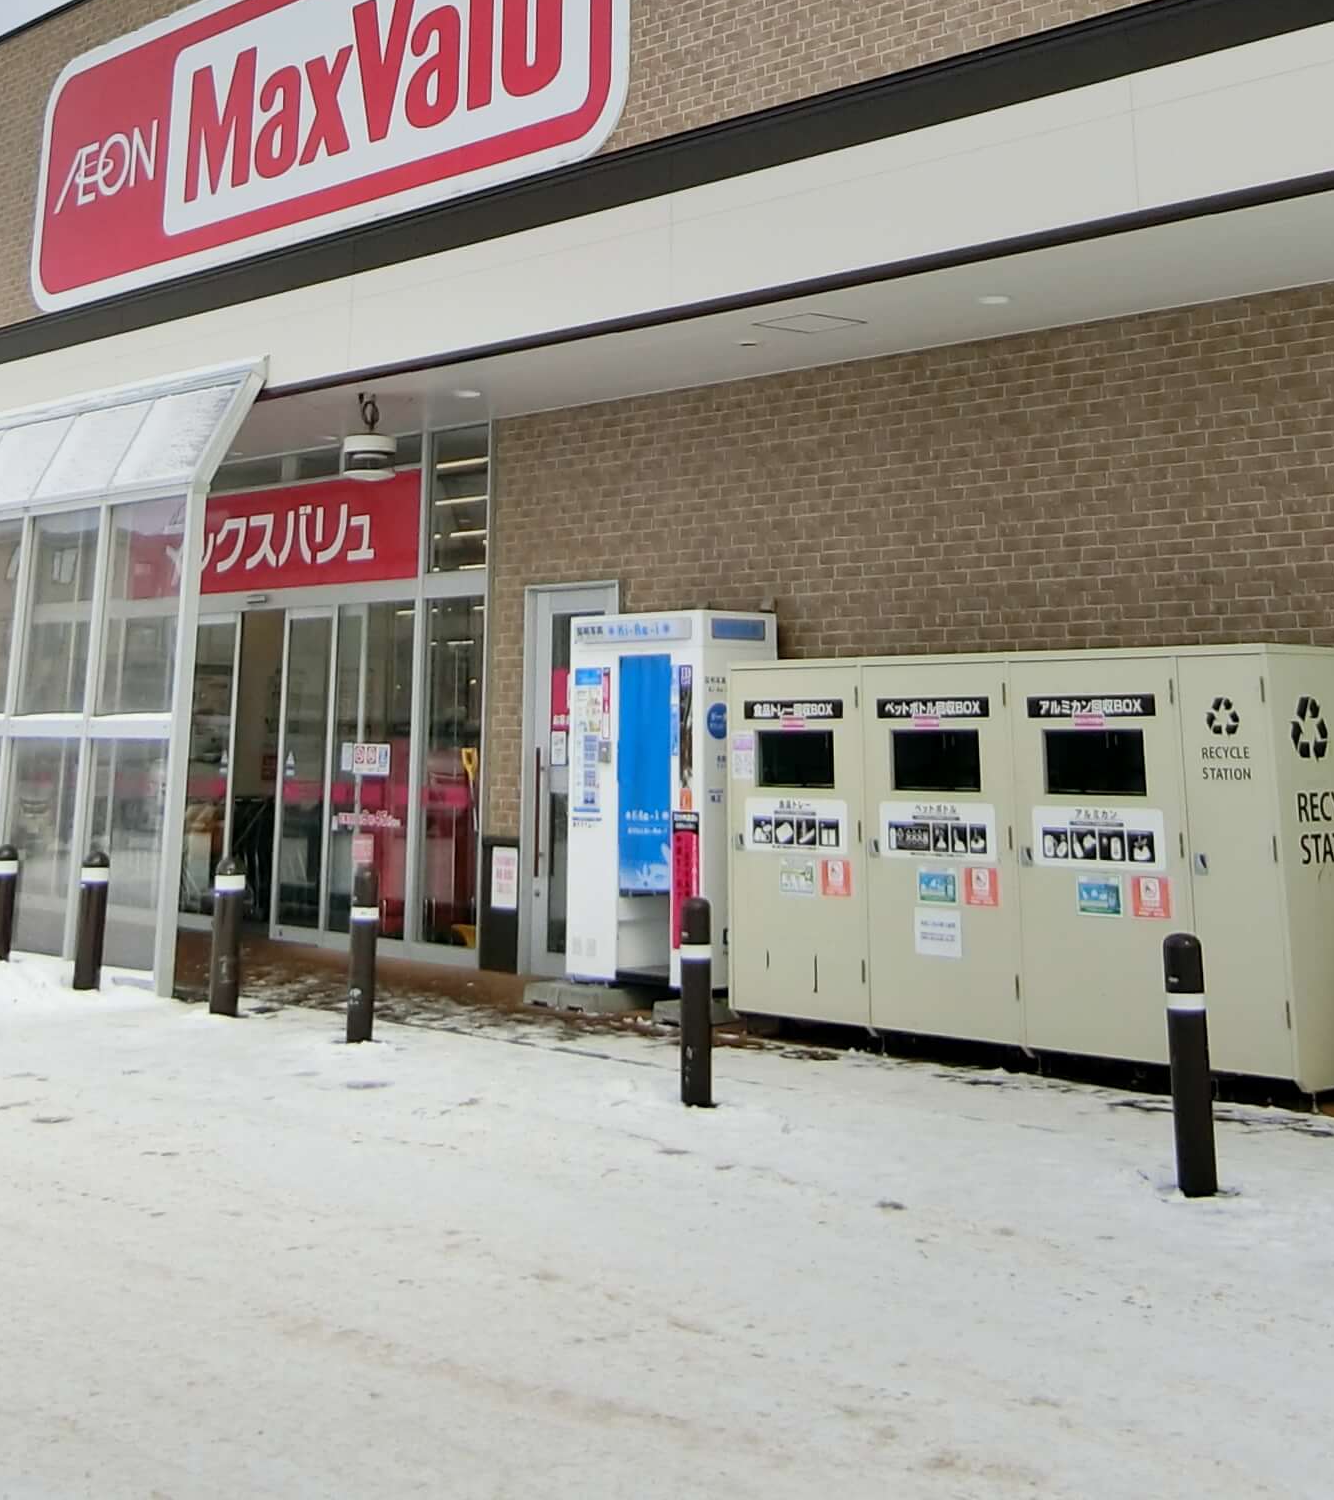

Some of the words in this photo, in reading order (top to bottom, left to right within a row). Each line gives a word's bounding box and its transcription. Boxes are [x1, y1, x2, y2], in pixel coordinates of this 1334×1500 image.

[753, 702, 834, 718] 食品トレー回収BOX
[884, 700, 981, 716] ペットボトル回収BOX
[1038, 698, 1143, 715] アルミカン回収BOX
[1201, 746, 1251, 760] RECYCLE
[1202, 767, 1252, 781] STATION
[914, 803, 958, 815] ペットボトル
[1074, 808, 1119, 820] アルミカン
